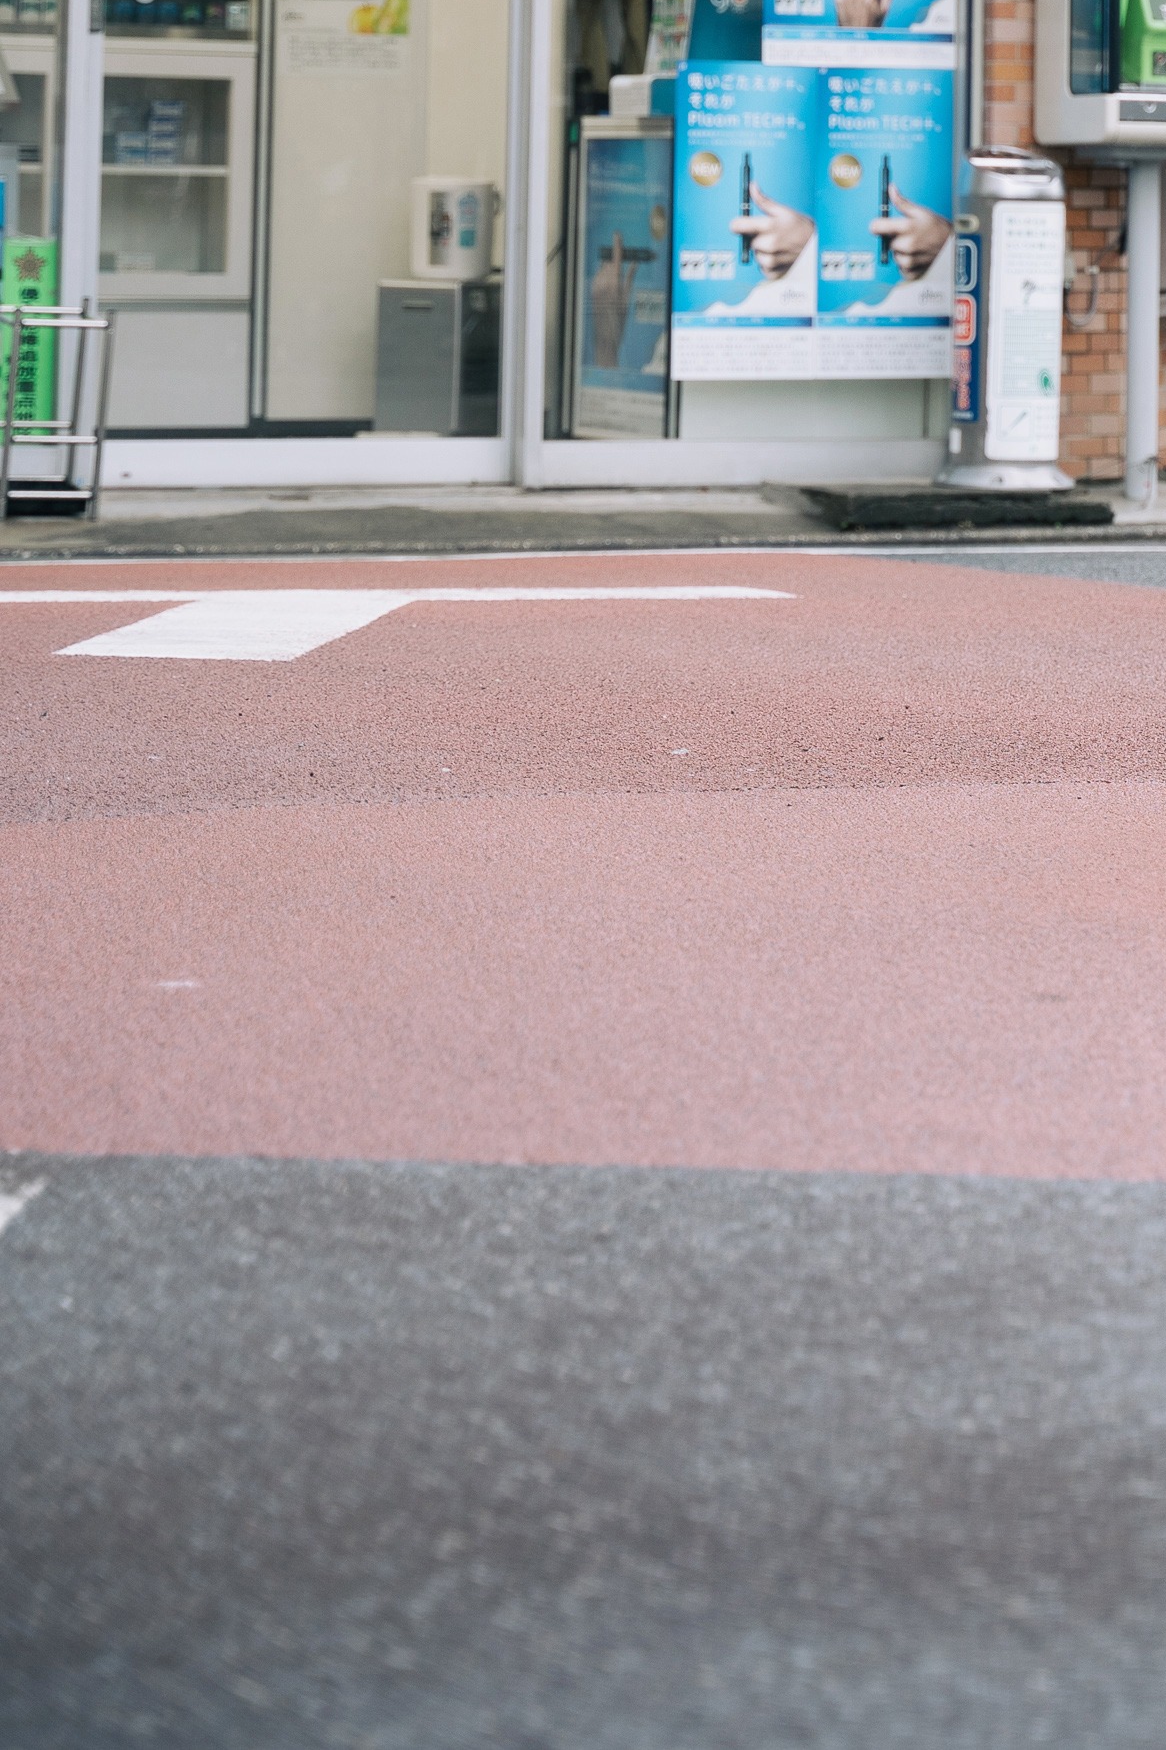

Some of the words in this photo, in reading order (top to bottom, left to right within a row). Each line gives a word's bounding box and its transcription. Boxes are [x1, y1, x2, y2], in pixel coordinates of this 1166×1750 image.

[688, 110, 739, 128] Ploom
[828, 114, 879, 131] Ploom
[691, 161, 720, 177] NEW
[832, 164, 860, 179] NEW
